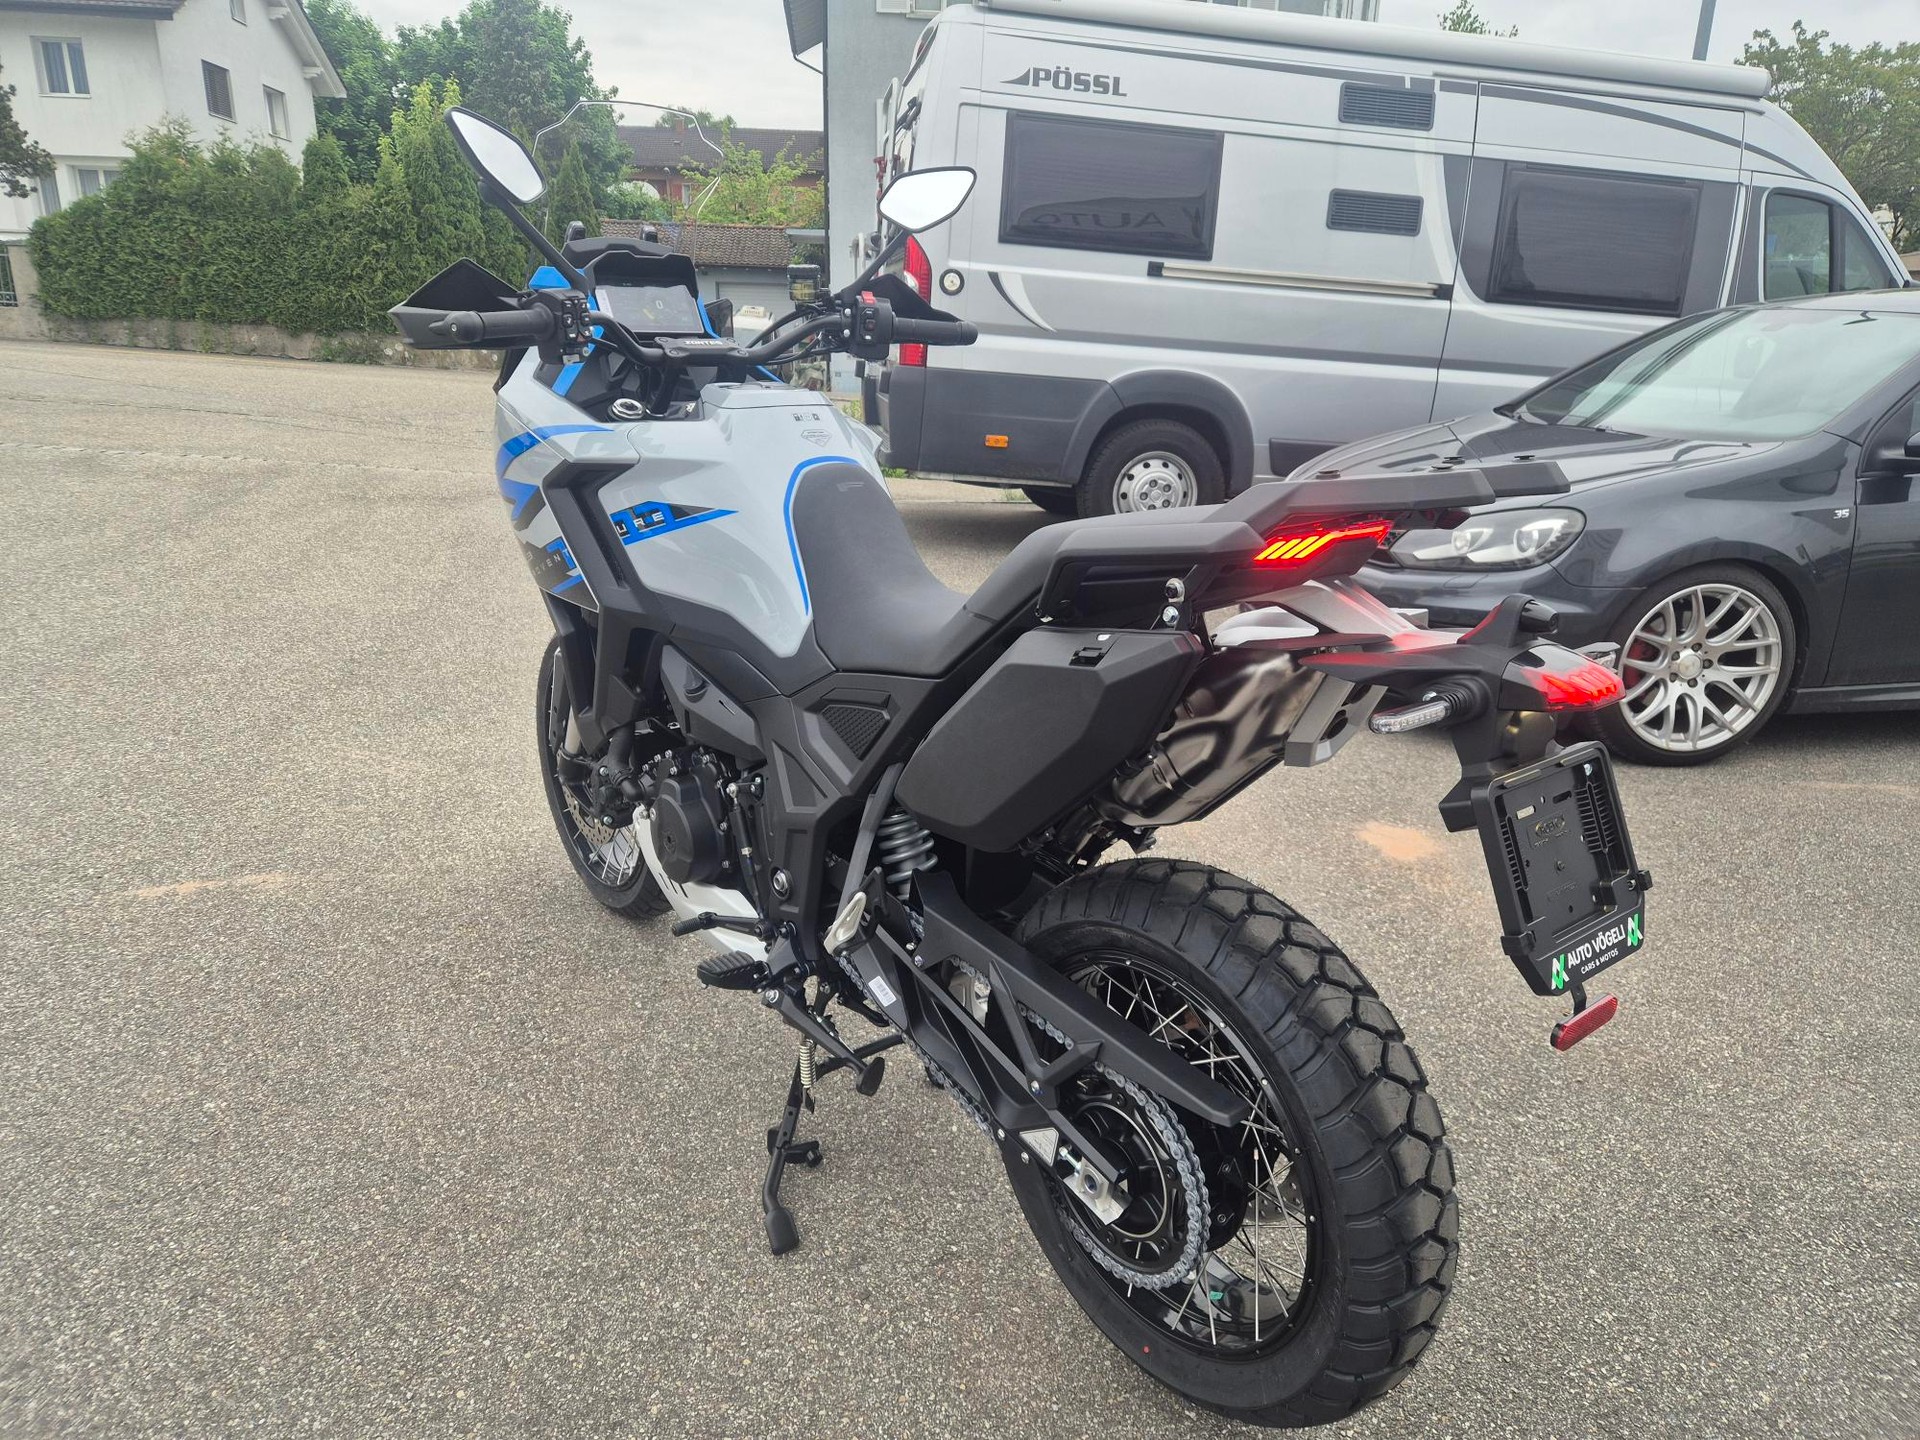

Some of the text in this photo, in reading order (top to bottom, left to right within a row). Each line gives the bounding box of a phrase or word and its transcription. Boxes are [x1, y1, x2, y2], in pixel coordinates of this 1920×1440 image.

[1032, 66, 1127, 96] PÖSSL
[1833, 508, 1850, 519] 35
[1568, 924, 1626, 969] AUTO VÖGELI
[1581, 962, 1596, 974] CARS
[1600, 948, 1619, 963] MOTOS
